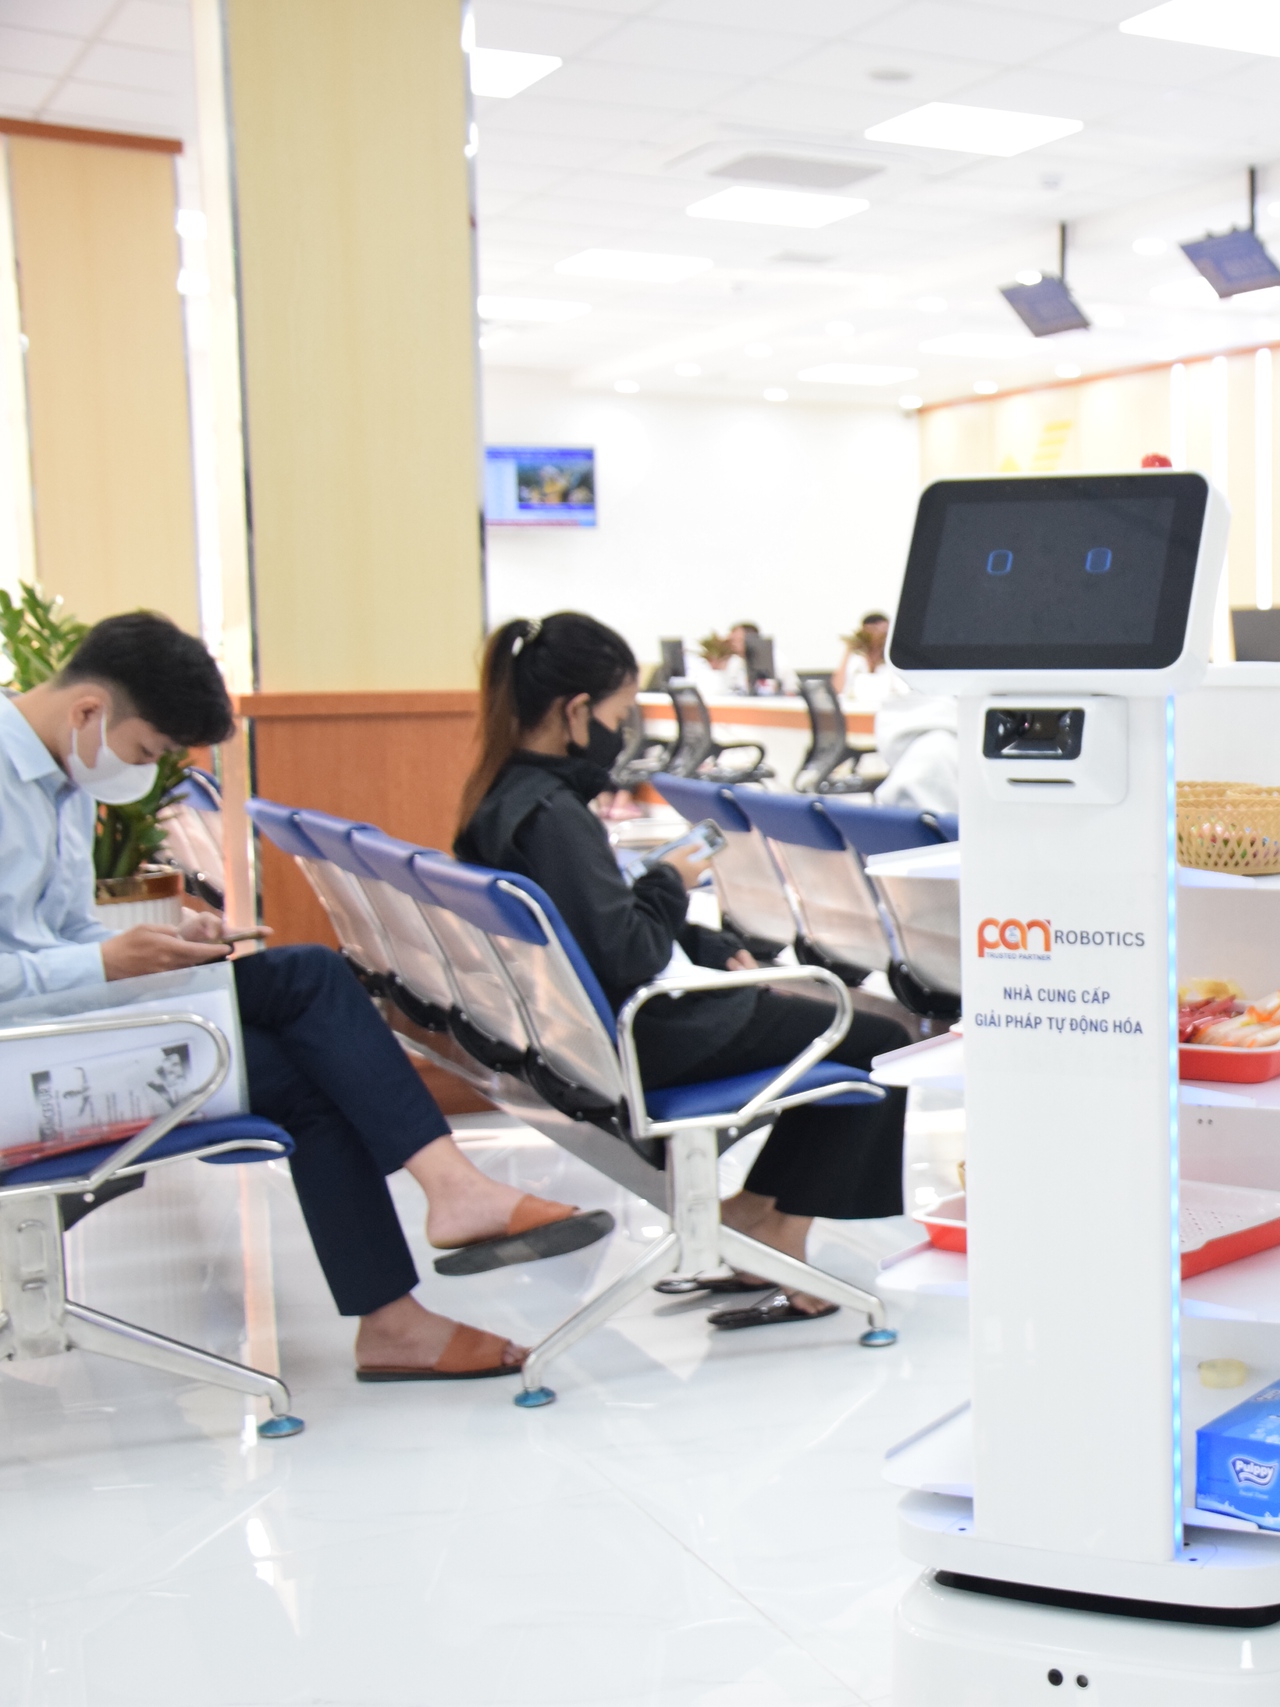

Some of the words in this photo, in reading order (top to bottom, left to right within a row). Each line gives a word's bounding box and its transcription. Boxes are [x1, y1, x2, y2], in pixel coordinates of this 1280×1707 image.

[1054, 929, 1146, 947] ROBOTICS
[986, 951, 1017, 960] TRUSTED
[1018, 952, 1052, 961] PARTNER
[1003, 985, 1033, 1001] NHÀ
[1037, 988, 1077, 1003] CUNG
[1081, 986, 1110, 1004] CẤP
[974, 1010, 1002, 1027] GIẢI
[1005, 1012, 1043, 1030] PHÁP
[1047, 1016, 1067, 1034] TỰ
[1069, 1015, 1109, 1035] ĐỘNG
[1113, 1018, 1144, 1035] HÓA
[1235, 1460, 1275, 1477] Pulppy
